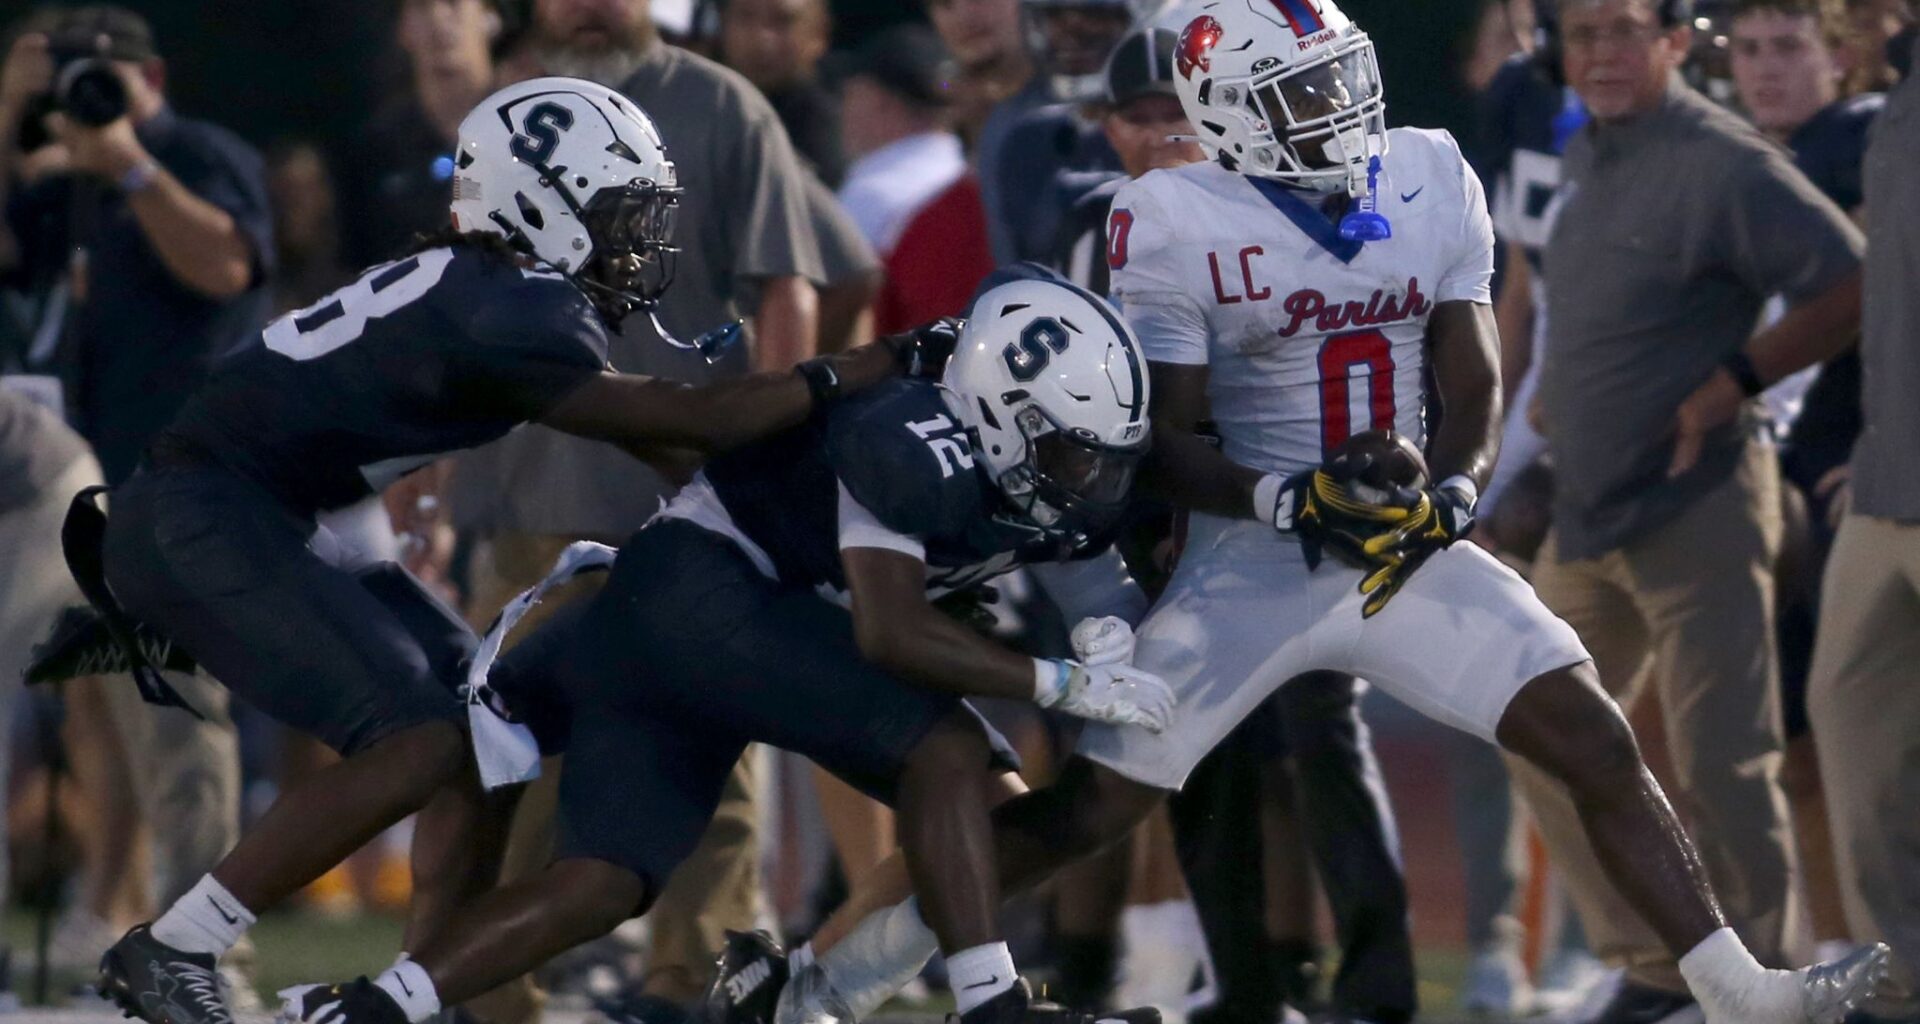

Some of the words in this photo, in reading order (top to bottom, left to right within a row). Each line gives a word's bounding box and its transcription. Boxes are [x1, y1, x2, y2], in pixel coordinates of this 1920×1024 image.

[509, 101, 574, 166] S
[1108, 208, 1134, 270] 0
[1208, 246, 1271, 305] LC
[1279, 277, 1431, 337] Parish
[1002, 316, 1070, 382] S
[1317, 328, 1397, 463] 0
[904, 413, 975, 479] 12
